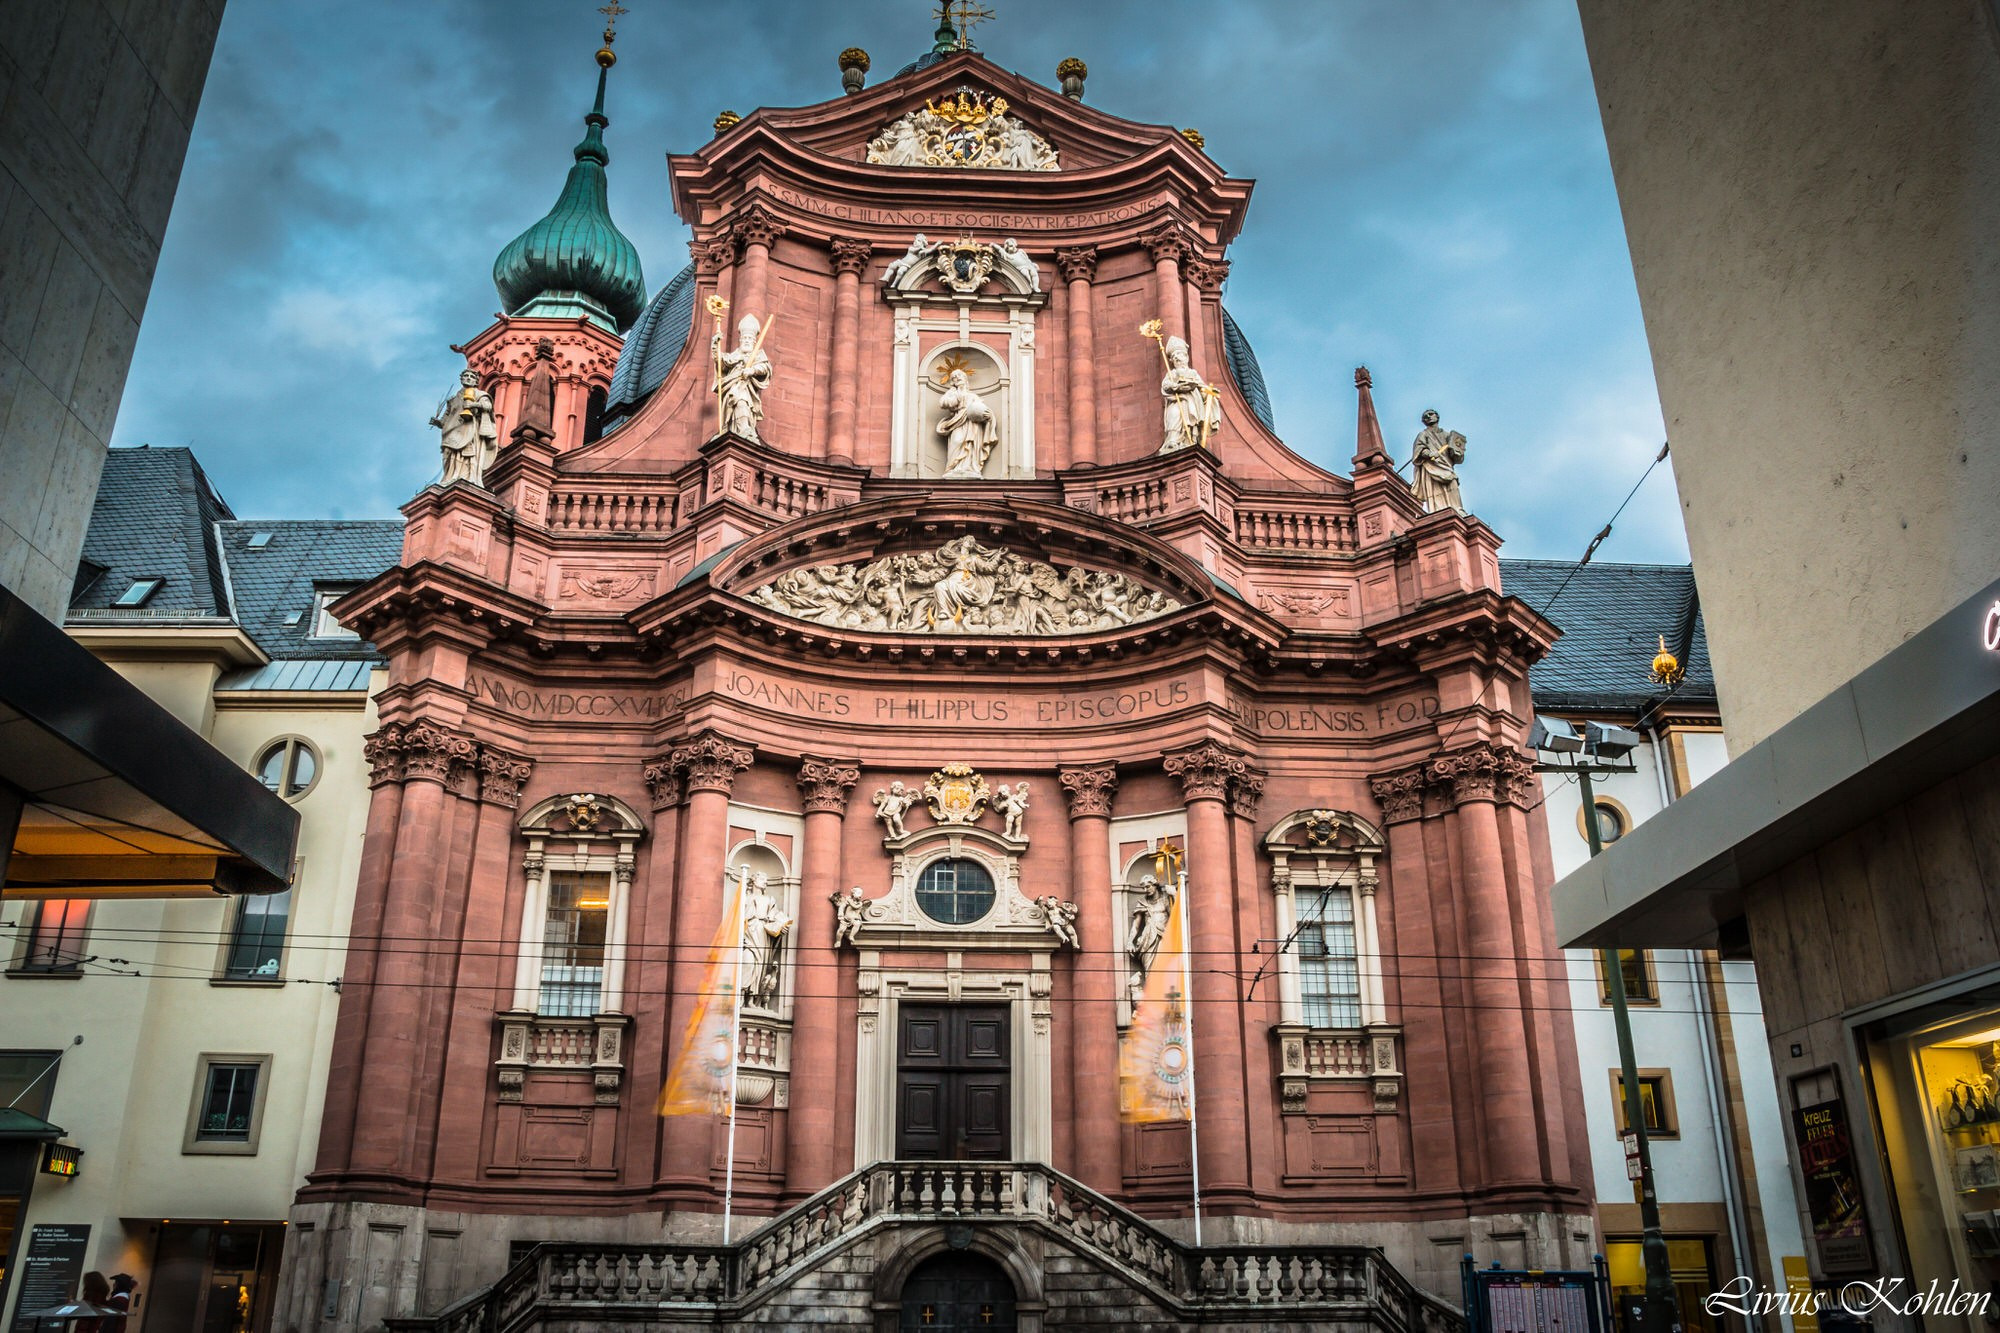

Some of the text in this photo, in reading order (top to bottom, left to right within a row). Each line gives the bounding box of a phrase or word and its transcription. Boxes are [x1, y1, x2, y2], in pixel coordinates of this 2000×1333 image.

[727, 671, 850, 716] JOANNES
[874, 697, 1008, 722] PHILIPPUS
[1036, 681, 1189, 722] EPISCOPUS
[1803, 1110, 1832, 1127] kreuz
